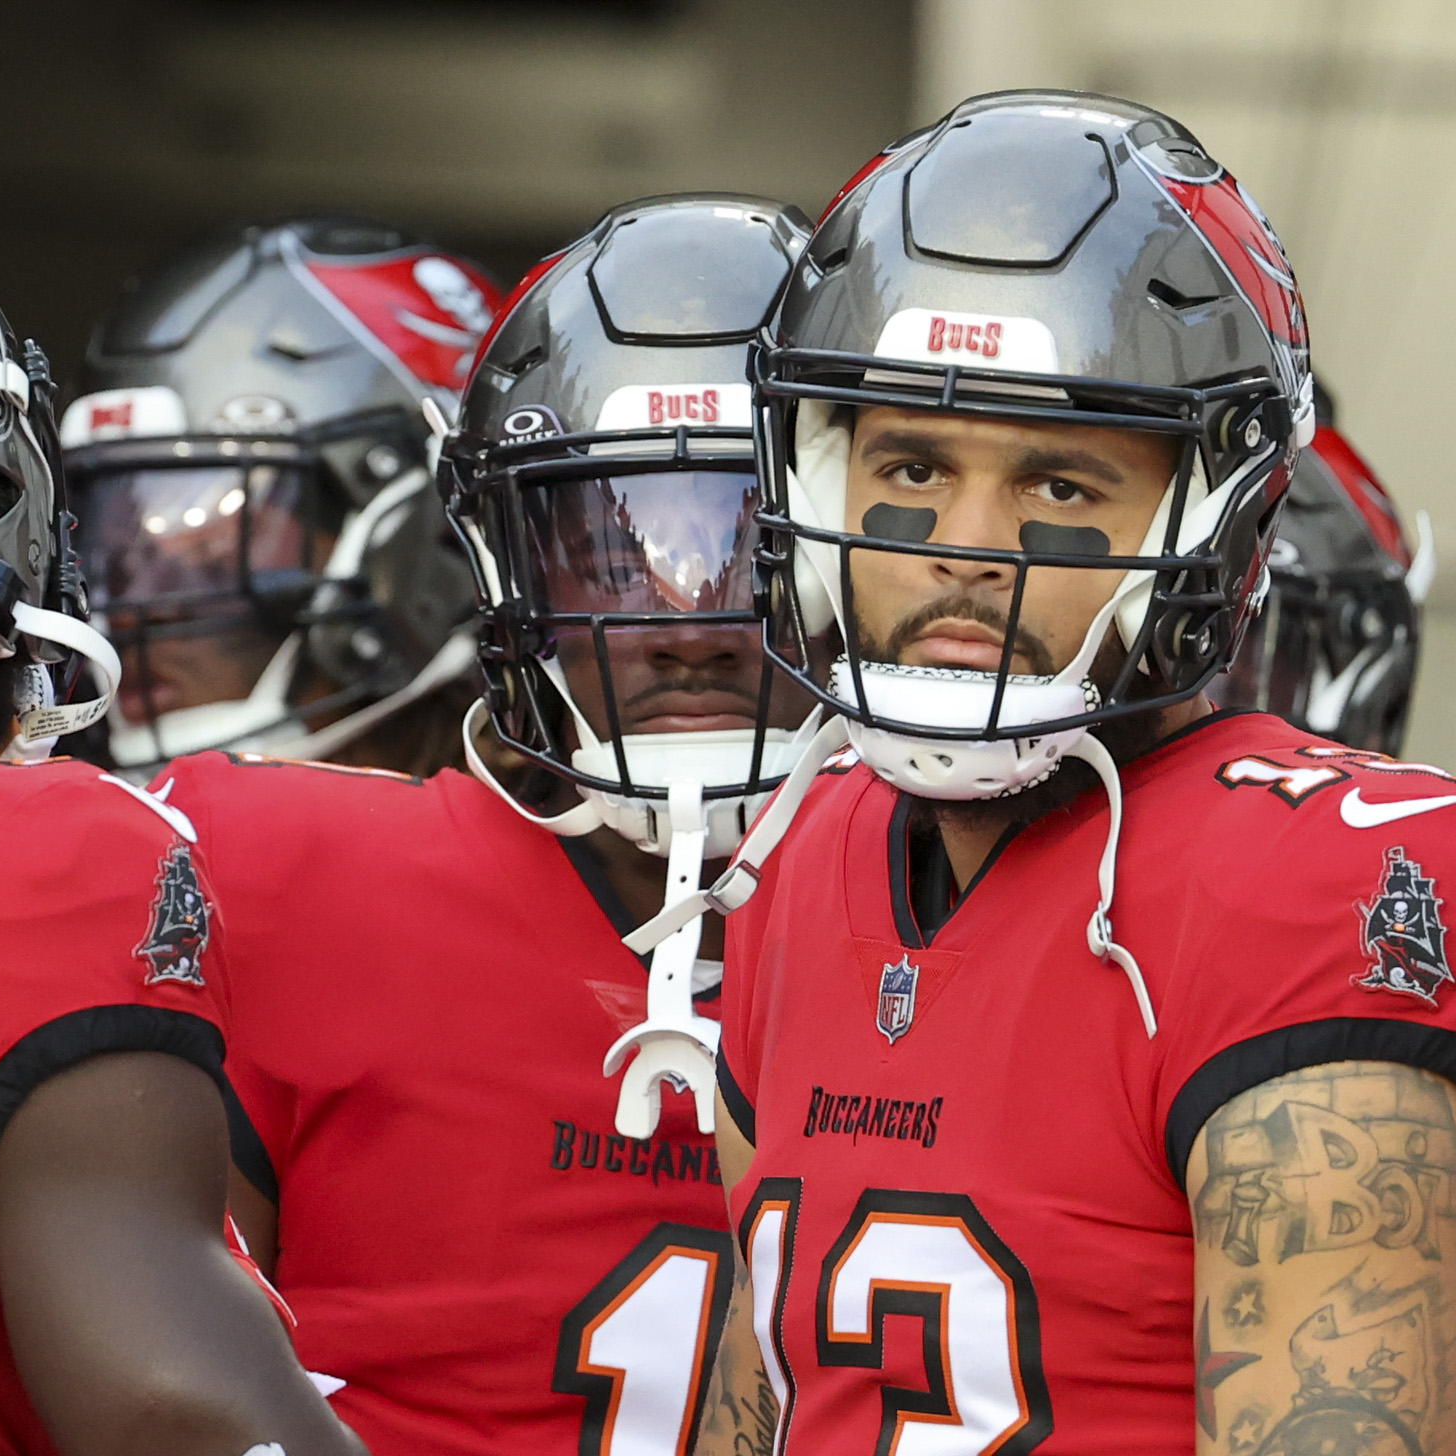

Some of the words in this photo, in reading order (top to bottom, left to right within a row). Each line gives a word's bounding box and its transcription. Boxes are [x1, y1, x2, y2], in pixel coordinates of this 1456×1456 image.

[928, 316, 1002, 357] BUCS
[648, 390, 717, 424] BUCS
[803, 1085, 943, 1149] BUCCANEERS
